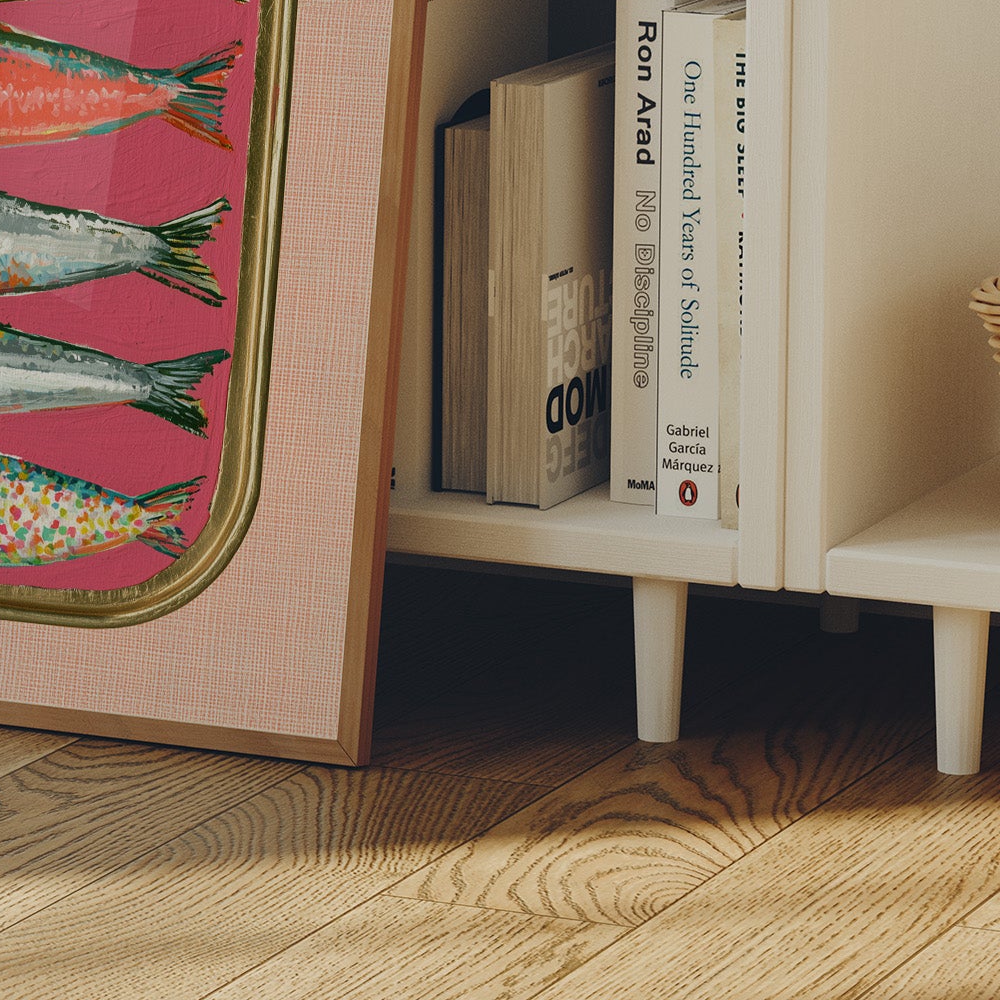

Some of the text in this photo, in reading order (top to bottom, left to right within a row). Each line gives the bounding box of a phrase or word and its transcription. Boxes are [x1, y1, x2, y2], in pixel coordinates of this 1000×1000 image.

[630, 21, 657, 389] Ron Arad No Discipline
[680, 61, 702, 379] One Hundred Years of Solitude
[546, 364, 608, 434] MOD
[666, 424, 710, 439] Gabriel
[668, 442, 706, 456] García
[661, 458, 714, 474] Márquez
[627, 479, 656, 491] MoMA
